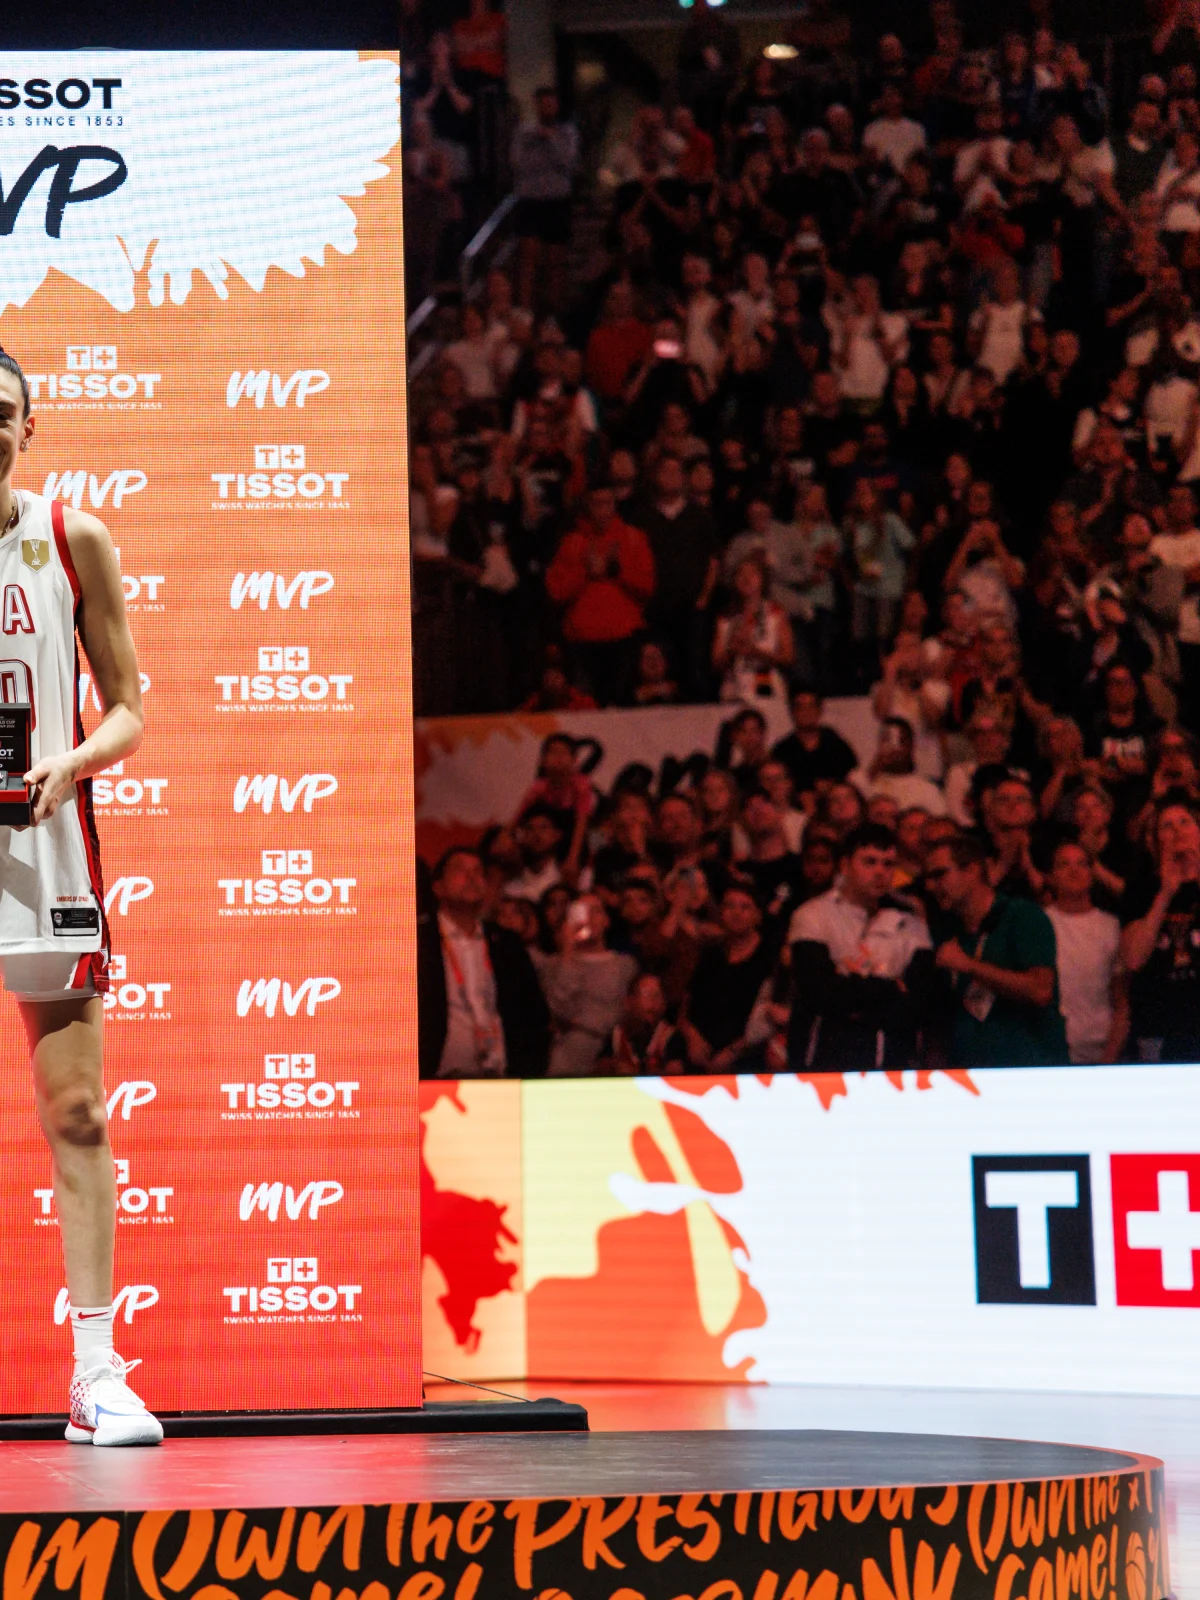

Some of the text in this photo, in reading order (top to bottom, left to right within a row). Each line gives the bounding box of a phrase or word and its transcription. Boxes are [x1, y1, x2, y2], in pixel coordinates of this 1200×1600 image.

[25, 116, 76, 127] SINCE
[87, 116, 124, 127] 1853
[25, 373, 161, 399] TISSOT
[226, 369, 330, 409] MVP
[43, 470, 148, 508] MVP
[211, 473, 349, 498] TISSOT
[230, 570, 334, 610] MVP
[215, 675, 353, 700] TISSOT
[234, 774, 338, 813] MVP
[218, 878, 356, 904] TISSOT
[237, 977, 341, 1017] MVP
[221, 1082, 359, 1108] TISSOT
[239, 1181, 343, 1221] MVP
[224, 1286, 362, 1312] TISSOT
